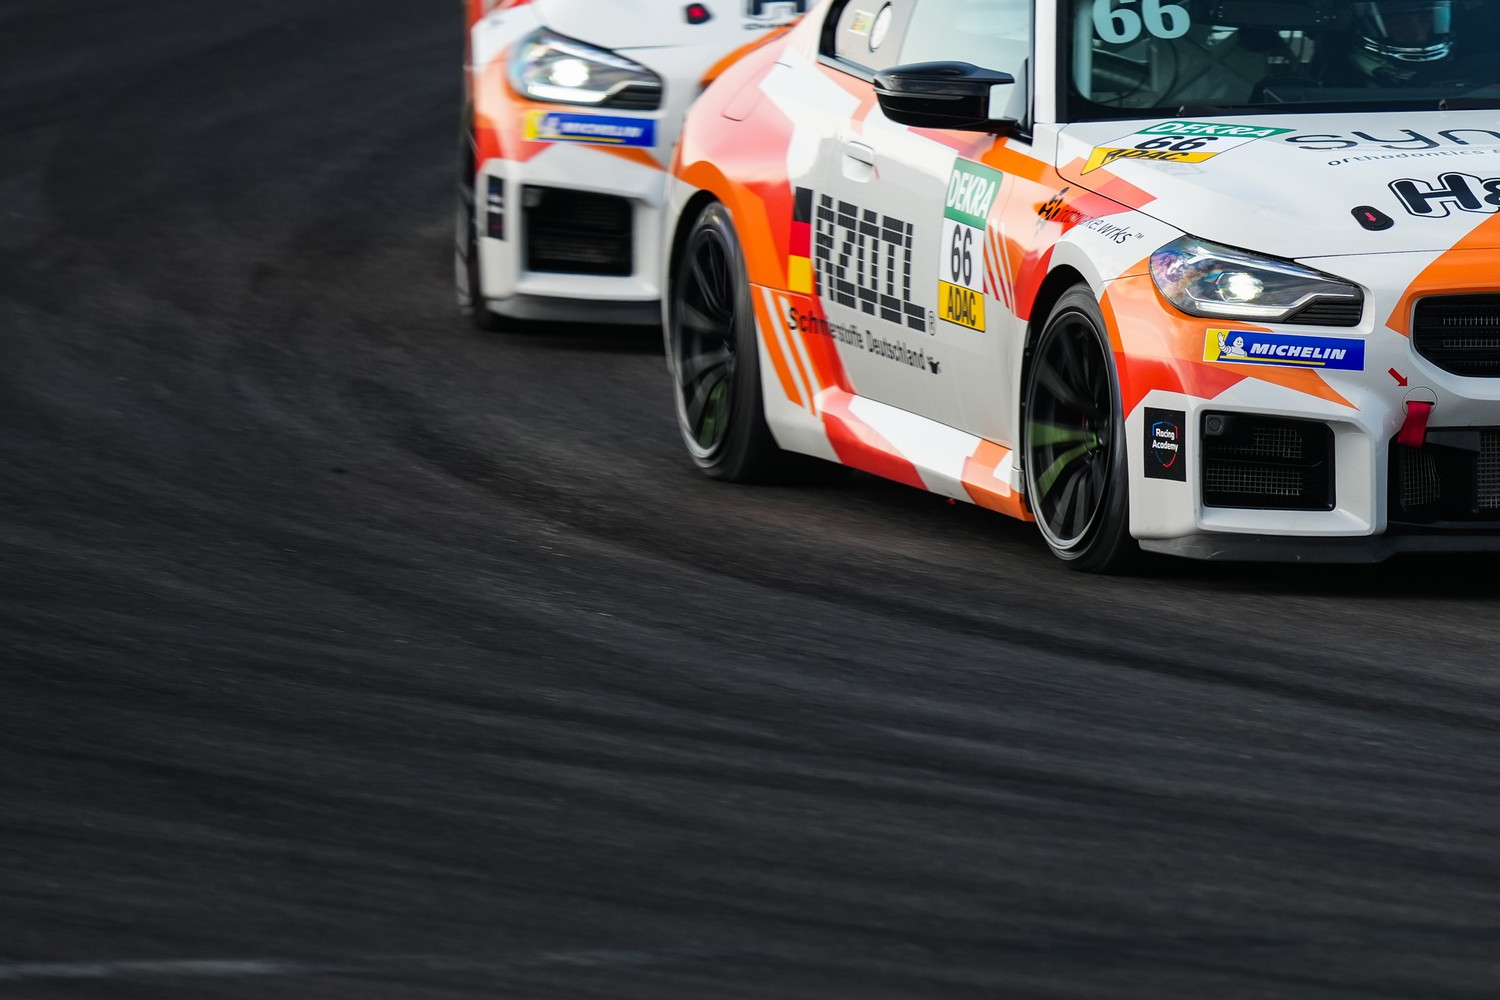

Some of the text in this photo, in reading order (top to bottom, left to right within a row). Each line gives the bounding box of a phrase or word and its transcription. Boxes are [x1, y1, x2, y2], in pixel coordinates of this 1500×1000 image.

[1146, 122, 1277, 137] DEKRA
[1134, 136, 1219, 151] 66
[1101, 149, 1189, 164] ADAC
[1328, 148, 1484, 167] orthodontics
[947, 169, 996, 220] DEKRA
[815, 193, 926, 333] RZOIL
[951, 224, 973, 287] 66
[946, 288, 976, 328] ADAC
[865, 329, 926, 371] Deutschland
[1250, 342, 1347, 361] MICHELIN
[1155, 427, 1175, 441] Racing
[1152, 440, 1179, 453] Academy
